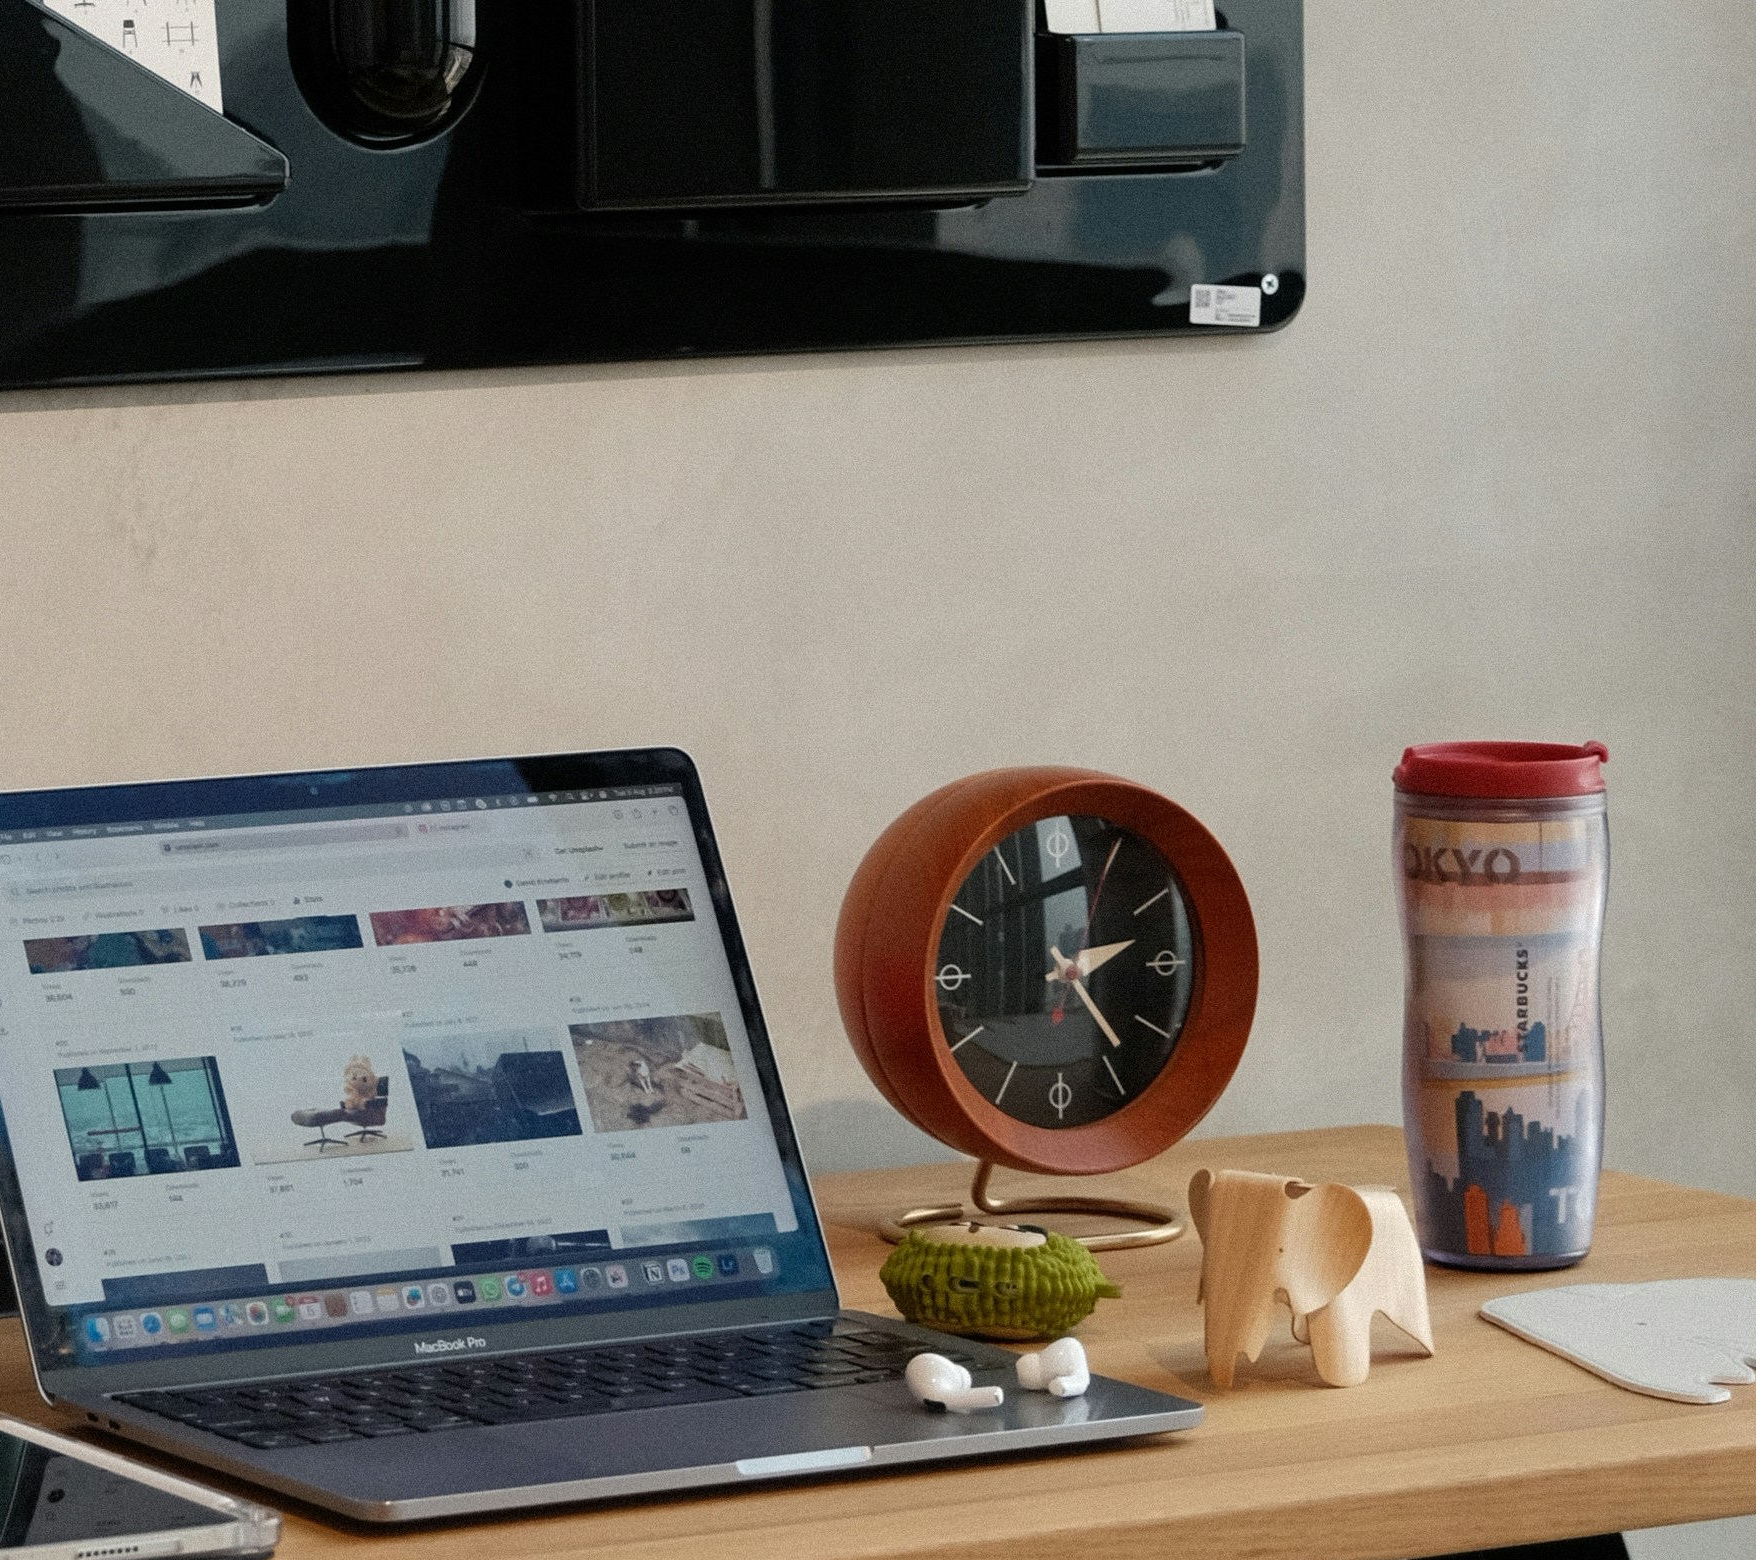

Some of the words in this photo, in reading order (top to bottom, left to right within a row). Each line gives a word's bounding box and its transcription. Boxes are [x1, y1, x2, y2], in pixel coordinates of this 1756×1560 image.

[1516, 948, 1529, 1052] STARBUCKS
[671, 1263, 685, 1277] Ps
[413, 1338, 466, 1354] MacBook
[466, 1336, 487, 1348] Pro
